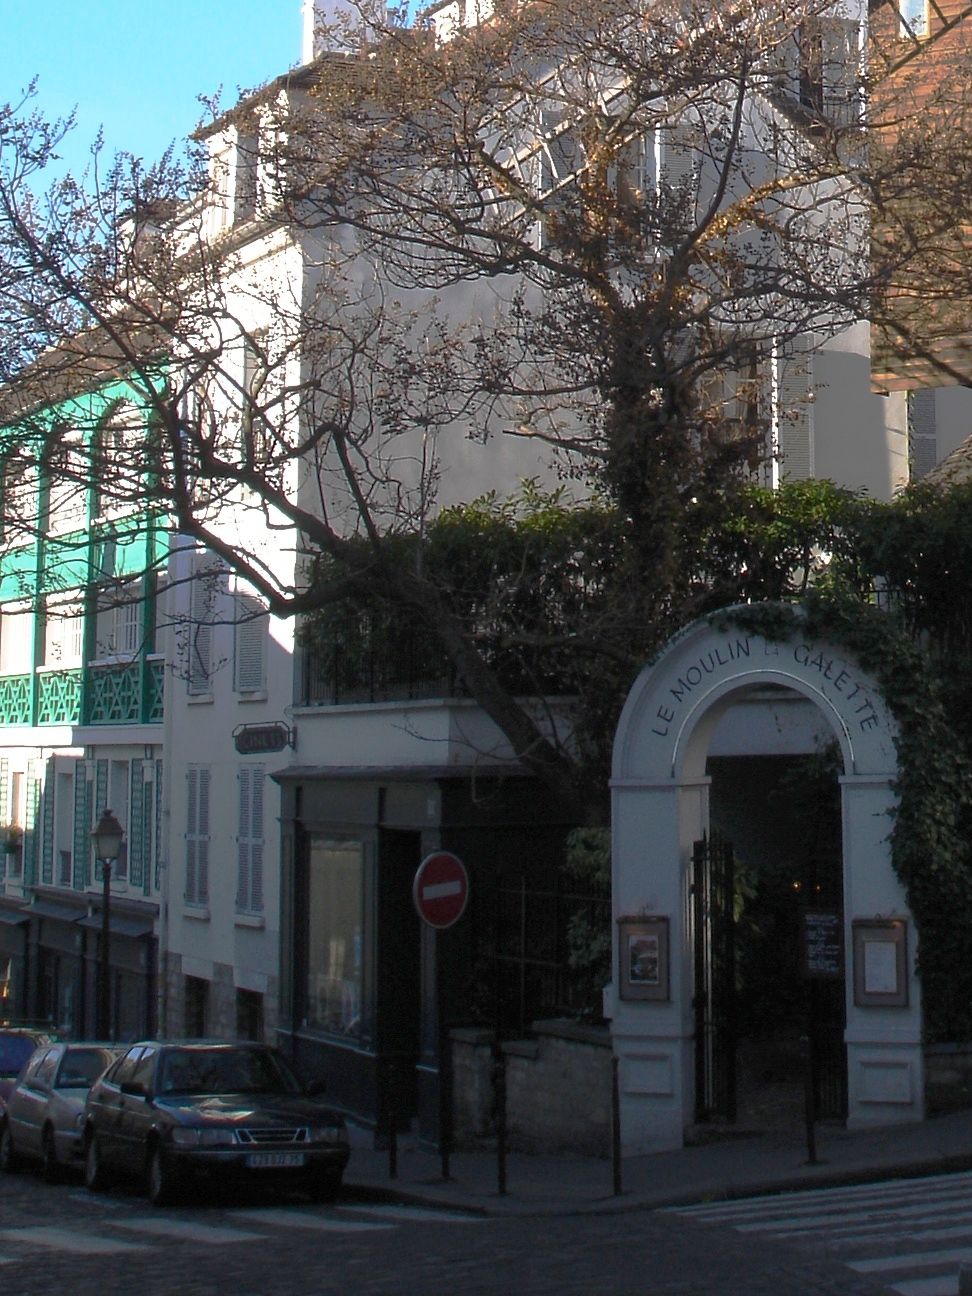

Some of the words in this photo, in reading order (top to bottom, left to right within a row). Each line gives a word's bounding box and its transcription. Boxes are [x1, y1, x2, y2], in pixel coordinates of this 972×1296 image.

[652, 704, 675, 737] LE
[670, 638, 751, 702] MOULIN
[793, 644, 879, 732] GALETTE
